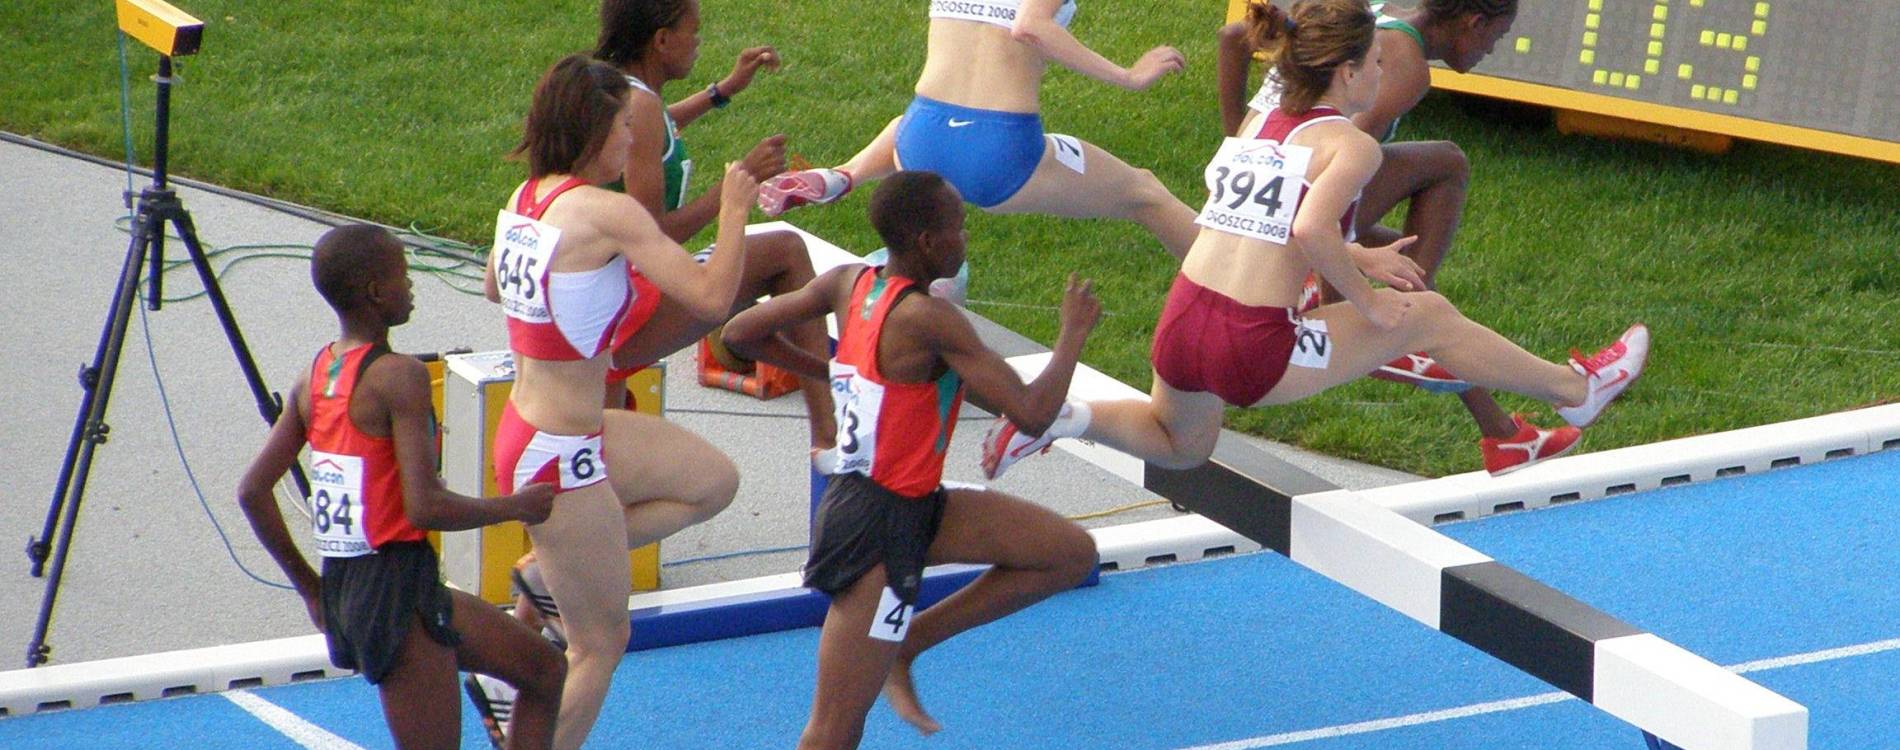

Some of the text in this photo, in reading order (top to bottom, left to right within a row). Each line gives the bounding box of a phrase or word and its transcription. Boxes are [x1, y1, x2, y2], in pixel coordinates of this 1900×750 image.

[988, 6, 1016, 20] 2008
[1256, 221, 1288, 239] 2008
[498, 247, 538, 300] 645
[1297, 329, 1327, 357] 2
[571, 447, 595, 480] 6
[883, 601, 904, 634] 4
